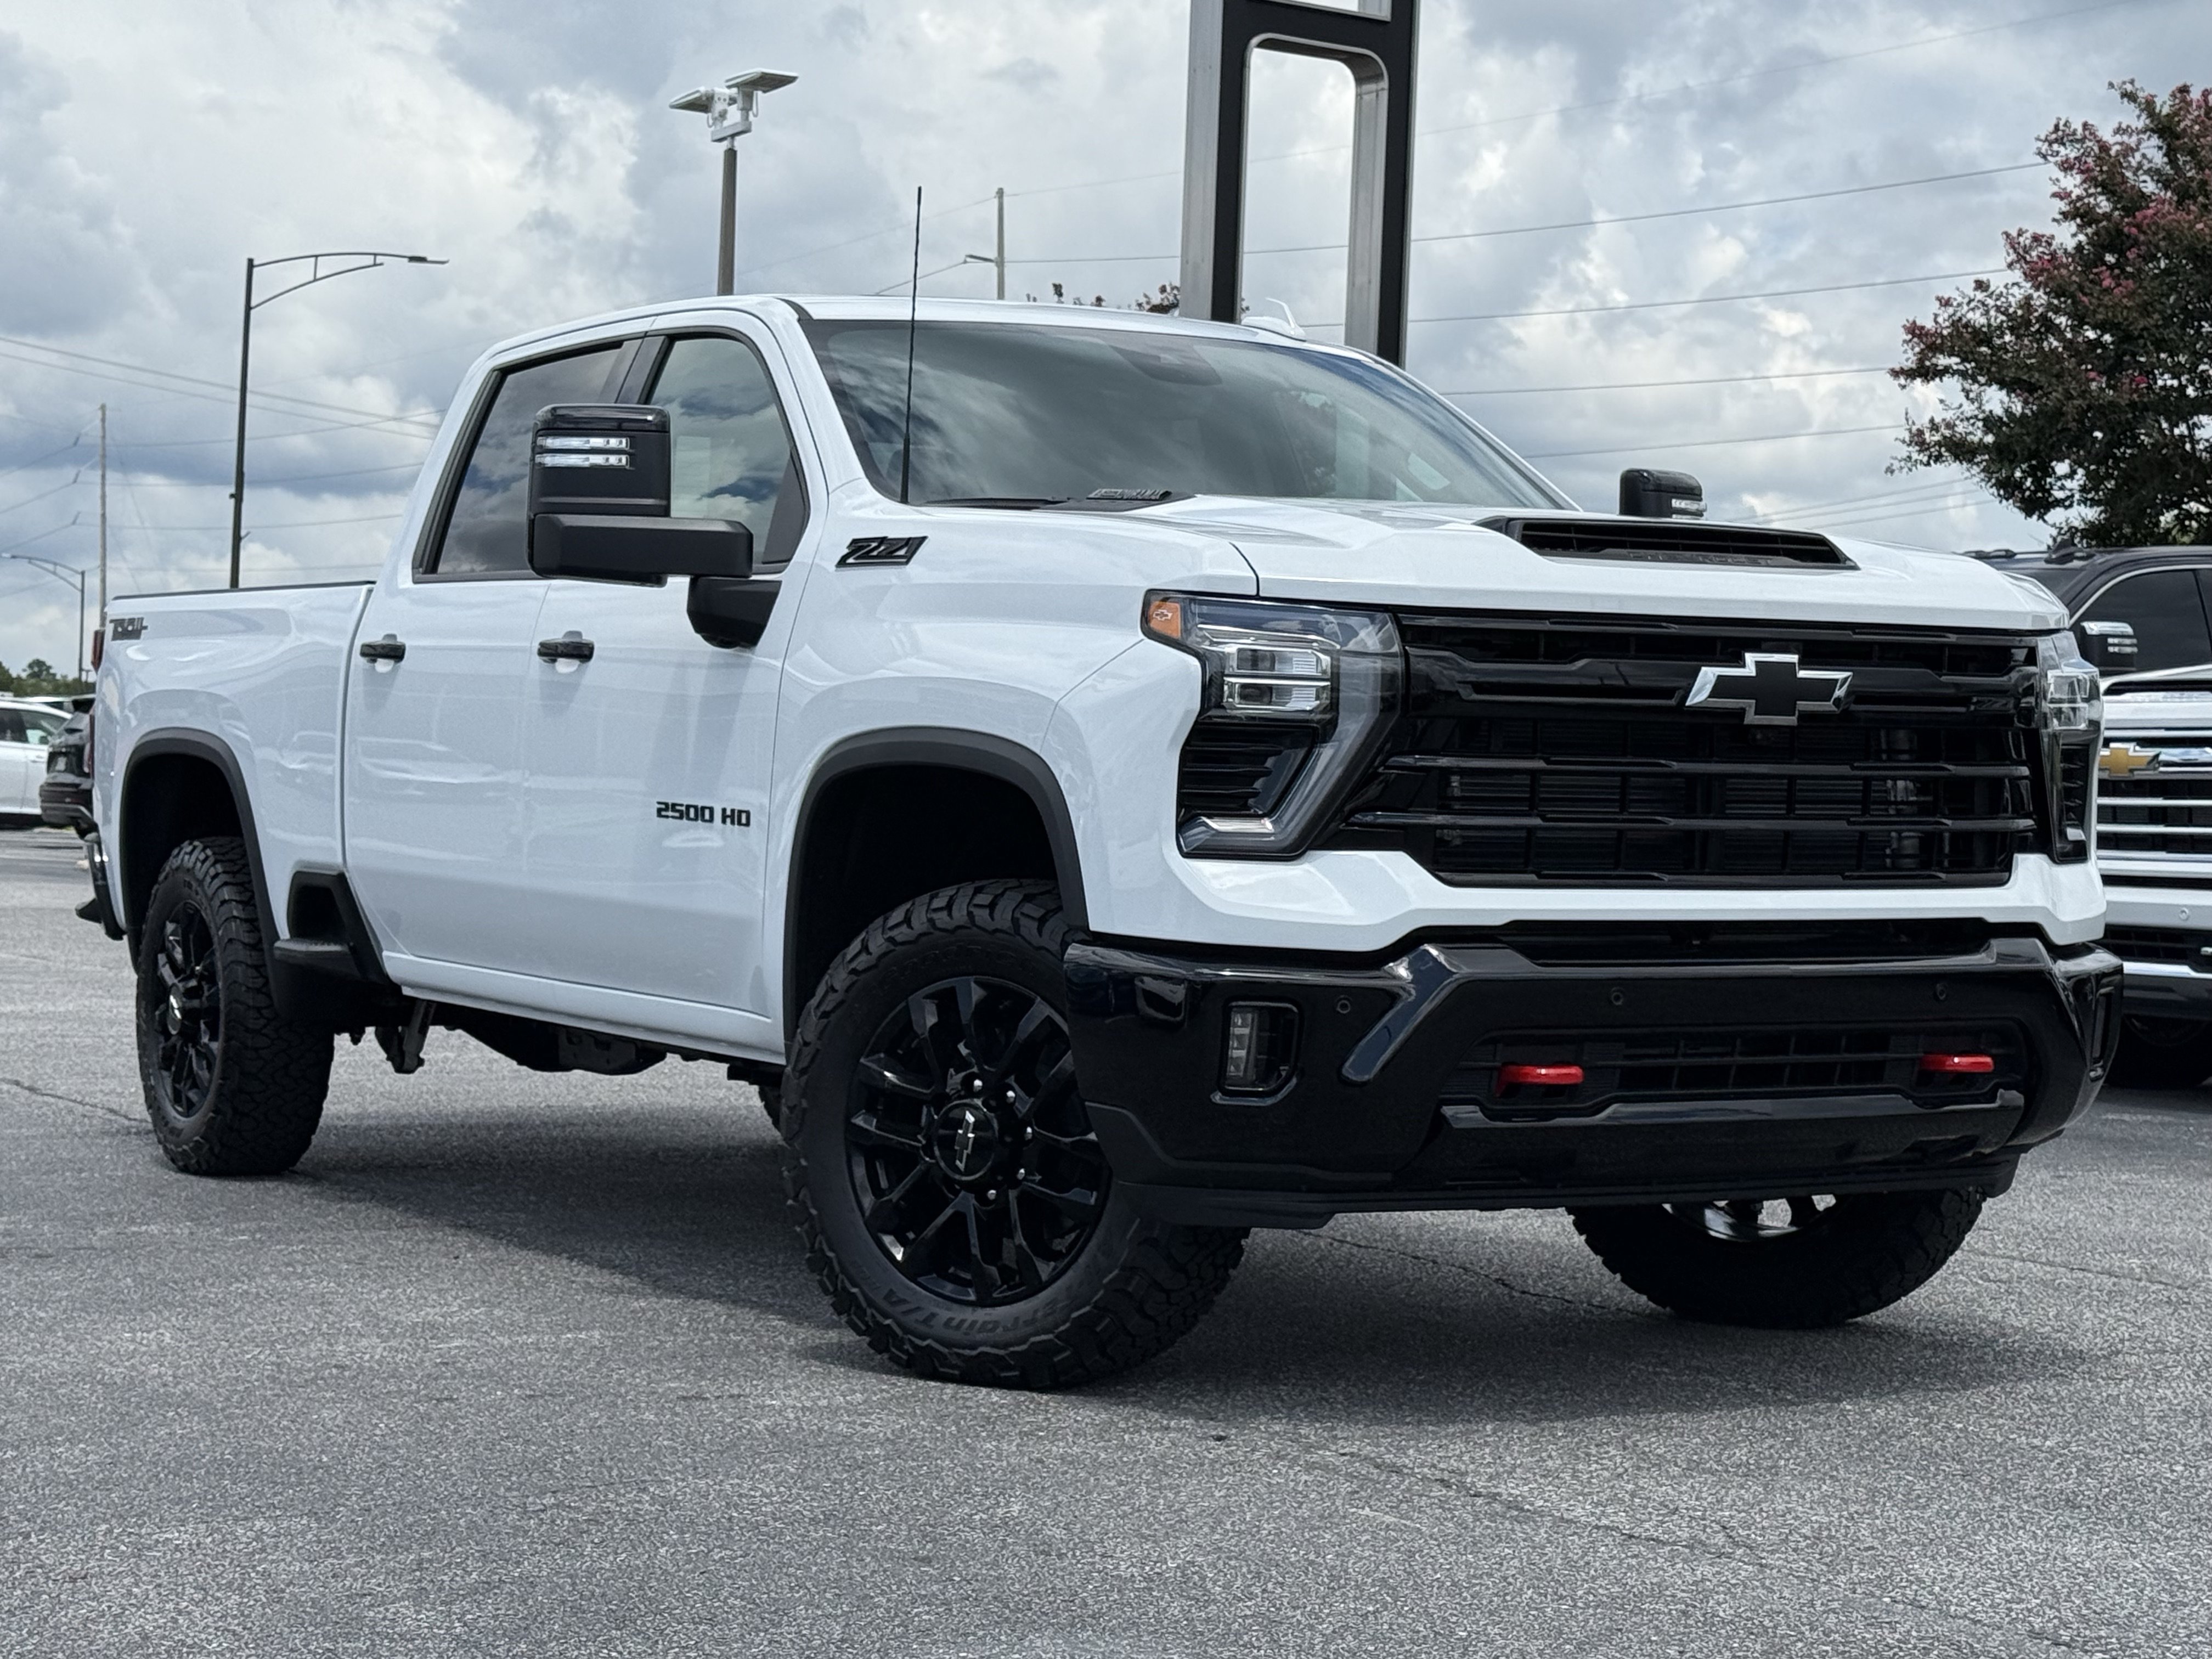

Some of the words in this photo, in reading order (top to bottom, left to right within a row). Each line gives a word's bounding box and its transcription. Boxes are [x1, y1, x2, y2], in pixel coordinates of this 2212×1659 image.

[835, 537, 928, 568] Z71
[656, 801, 714, 823] 2500
[721, 808, 751, 827] HD
